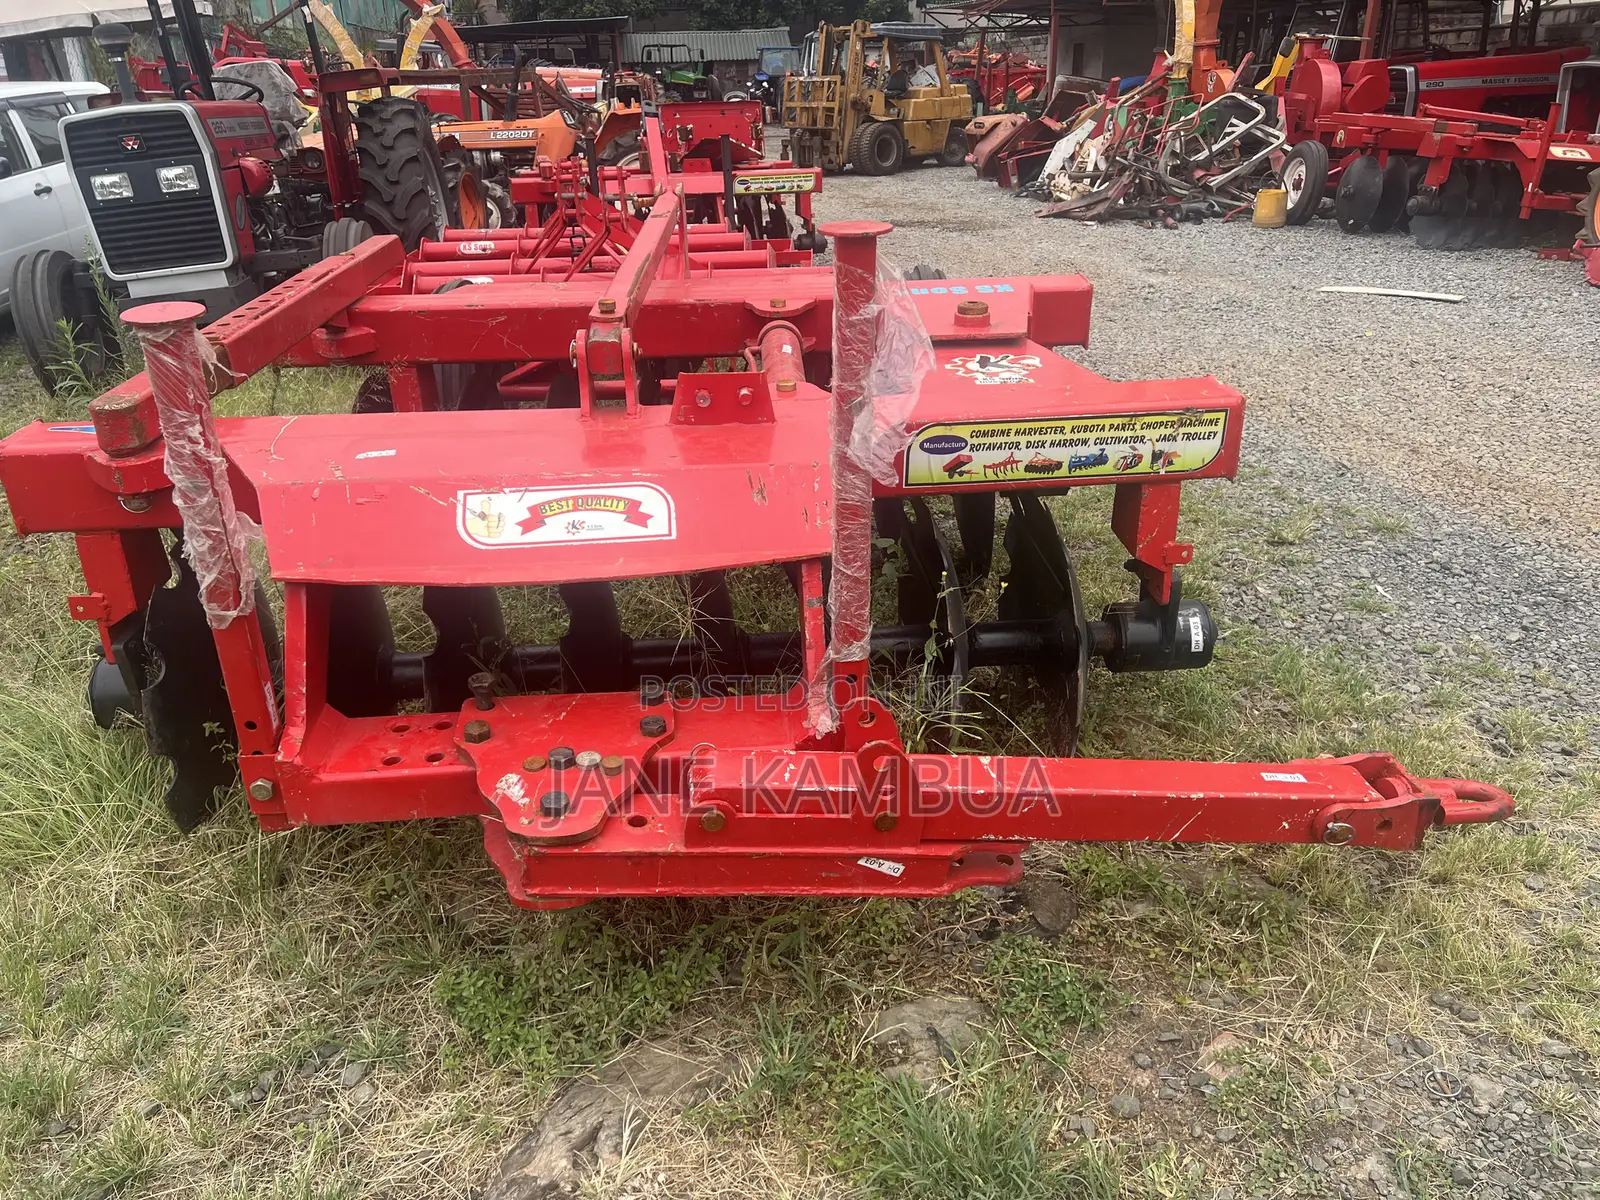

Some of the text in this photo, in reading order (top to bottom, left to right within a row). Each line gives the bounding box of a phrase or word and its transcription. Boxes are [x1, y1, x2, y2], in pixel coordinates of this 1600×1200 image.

[1481, 77, 1511, 85] MASSEY
[1513, 76, 1549, 84] FERGUSON
[490, 130, 535, 140] L2202DT
[969, 417, 1221, 440] COMBINE HARVESTER, KUBOTA PARTS, CHOPER MACHINE
[923, 440, 966, 450] Manufacture
[969, 440, 1023, 453] ROTAVATOR,
[1025, 439, 1048, 450] DISK
[1049, 437, 1091, 449] HARROW,
[1155, 432, 1178, 443] JACK
[1180, 430, 1219, 442] TROLLEY
[538, 496, 630, 515] BEST QUALITY
[1192, 621, 1200, 650] DH A-03
[864, 858, 885, 869] A-03
